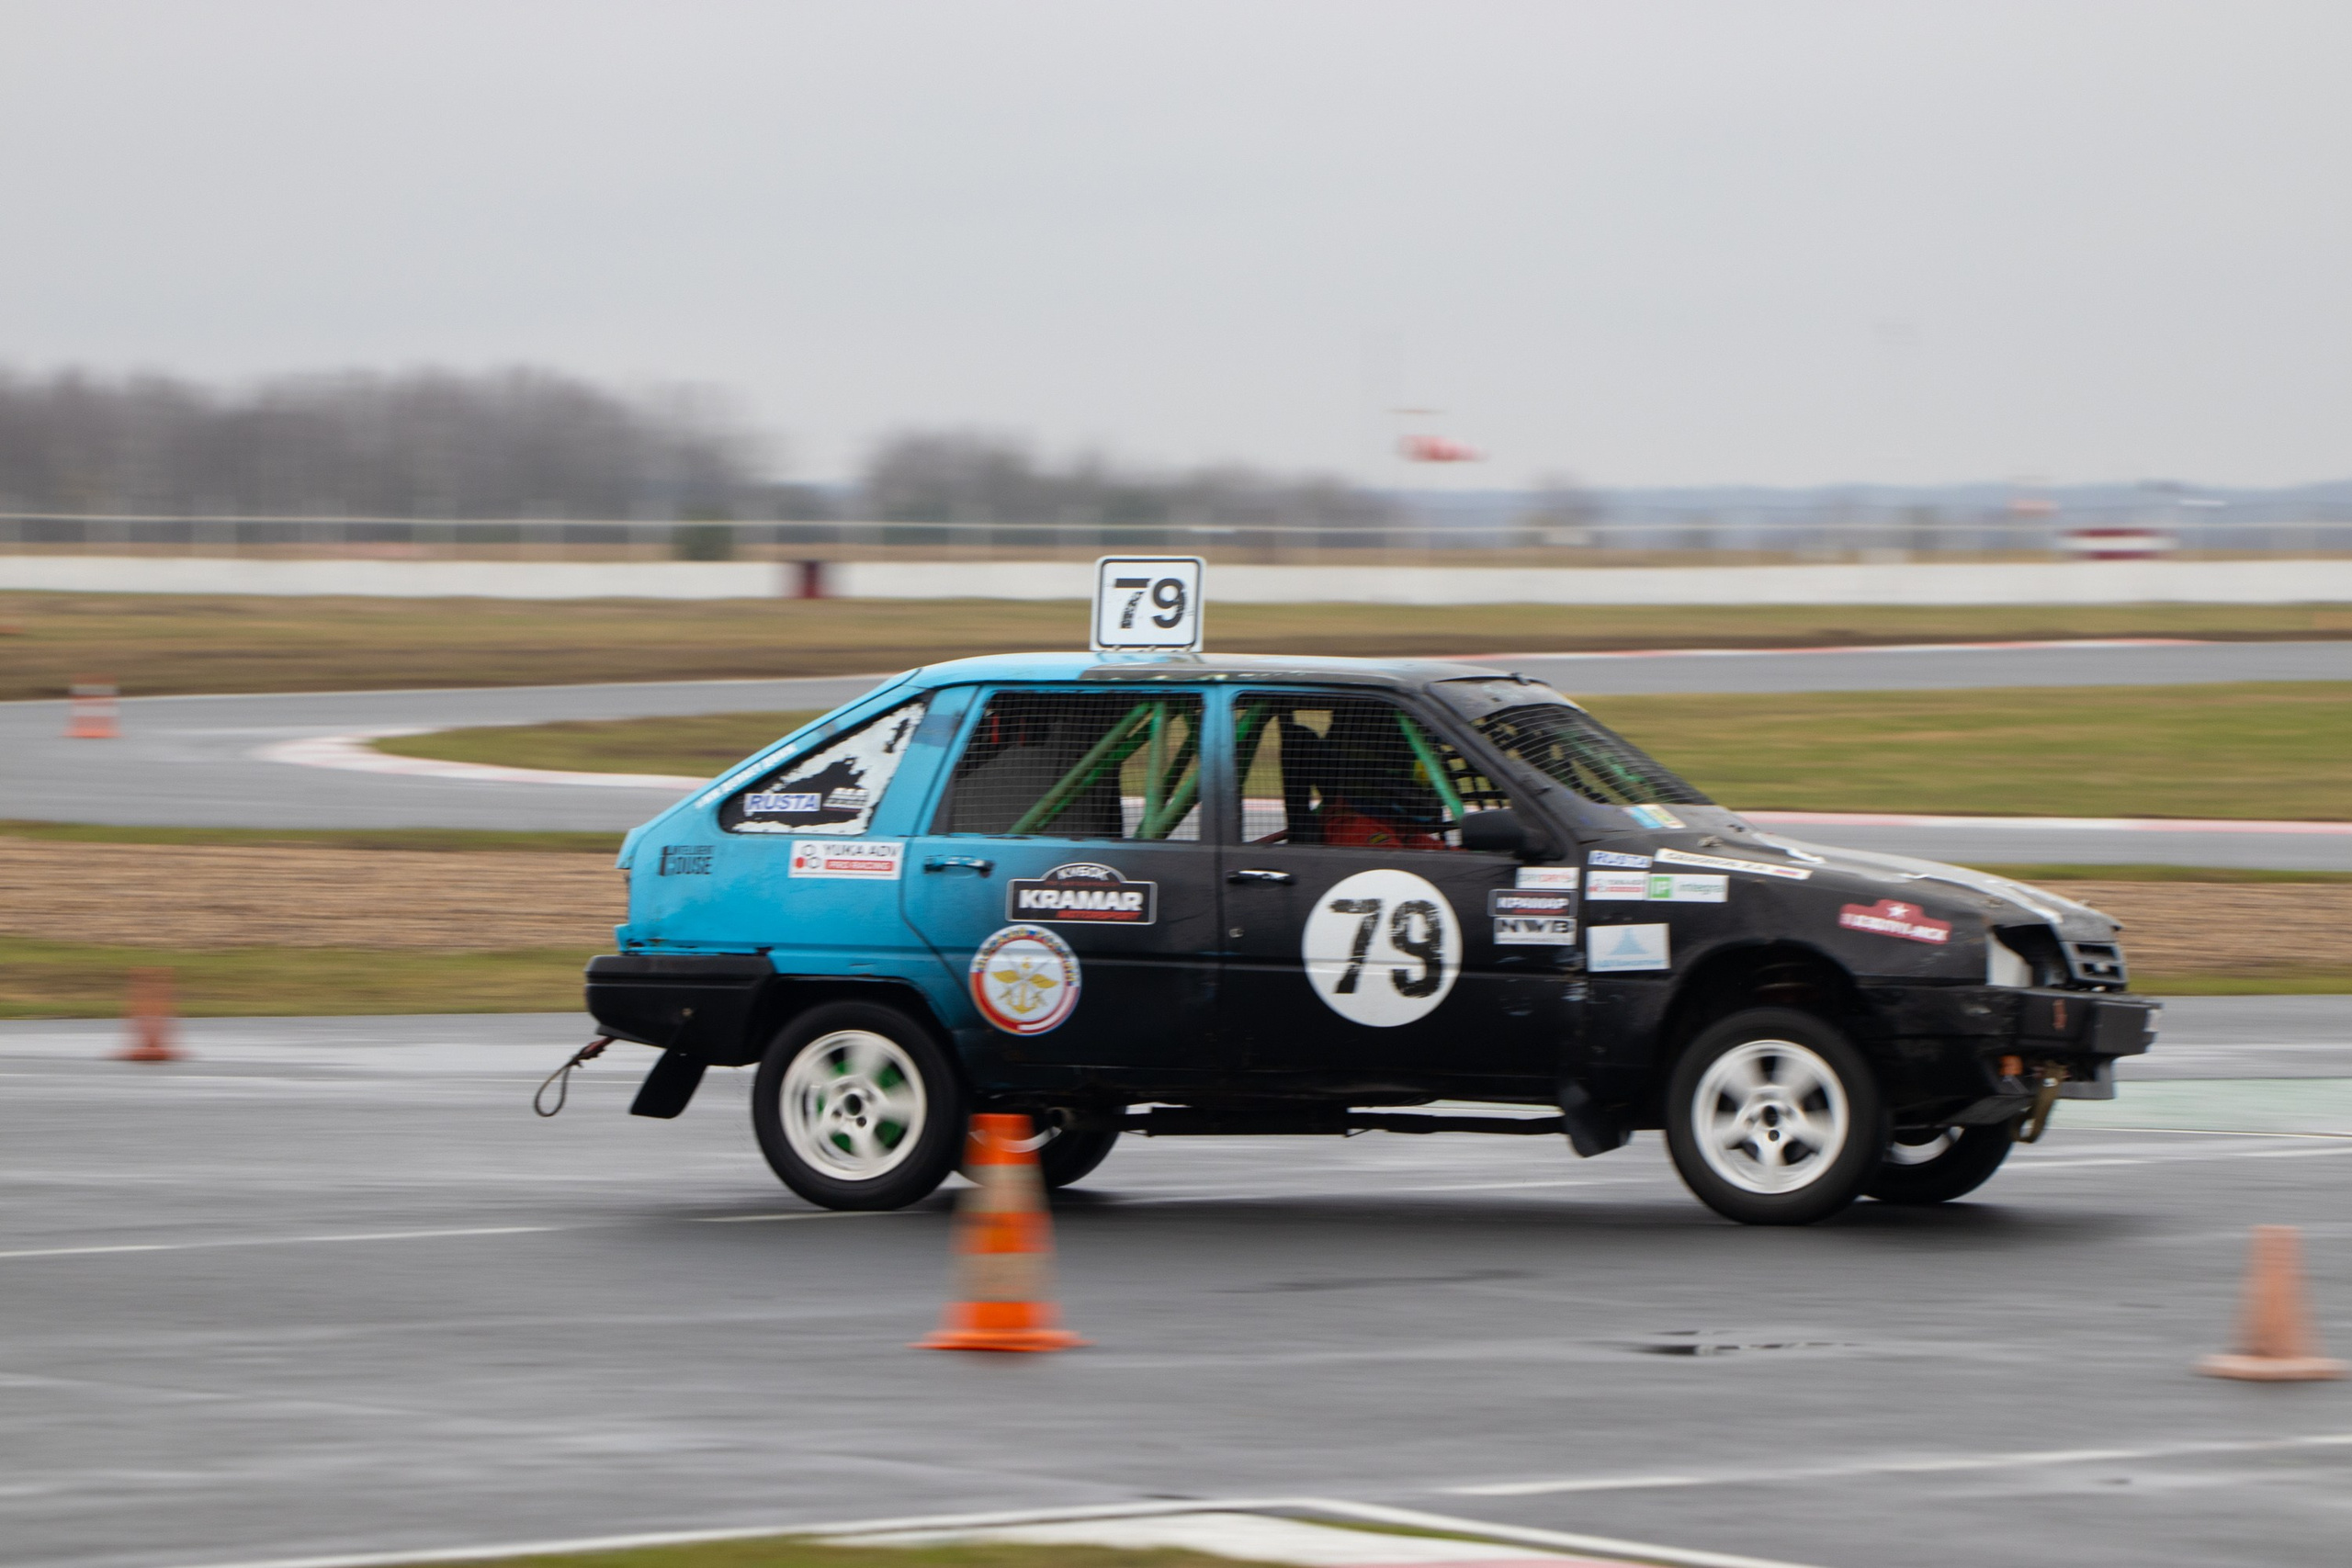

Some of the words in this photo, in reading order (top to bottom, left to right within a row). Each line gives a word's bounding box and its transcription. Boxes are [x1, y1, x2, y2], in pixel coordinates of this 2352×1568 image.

[1114, 578, 1186, 628] 79
[748, 794, 818, 810] RUSTA
[823, 844, 865, 856] YUKA
[1018, 889, 1144, 911] KRAMAR
[1329, 897, 1444, 999] 79
